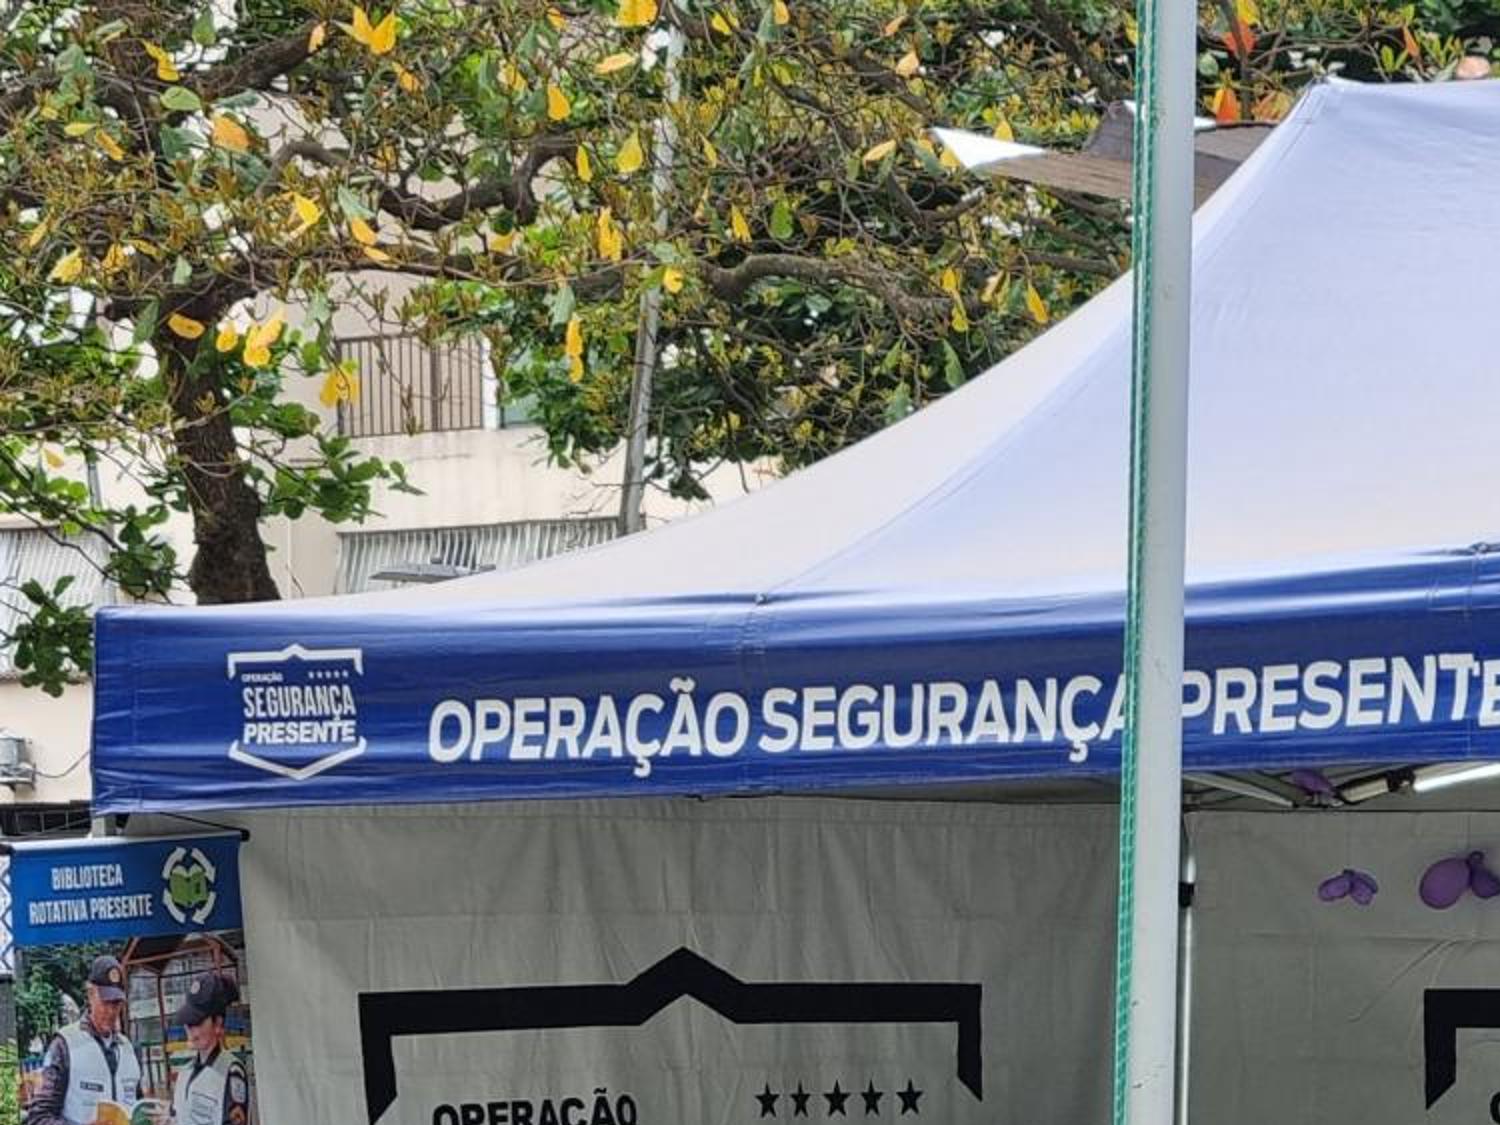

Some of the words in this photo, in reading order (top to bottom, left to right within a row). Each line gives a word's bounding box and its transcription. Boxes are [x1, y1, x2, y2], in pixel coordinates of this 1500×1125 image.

[242, 684, 358, 721] SEGURANÇA
[243, 718, 357, 745] PRESENTE
[427, 676, 750, 778] OPERAÇÃO
[51, 862, 124, 891] BIBLIOTECA
[29, 898, 89, 925] ROTATIVA
[91, 893, 154, 920] PRESENTE
